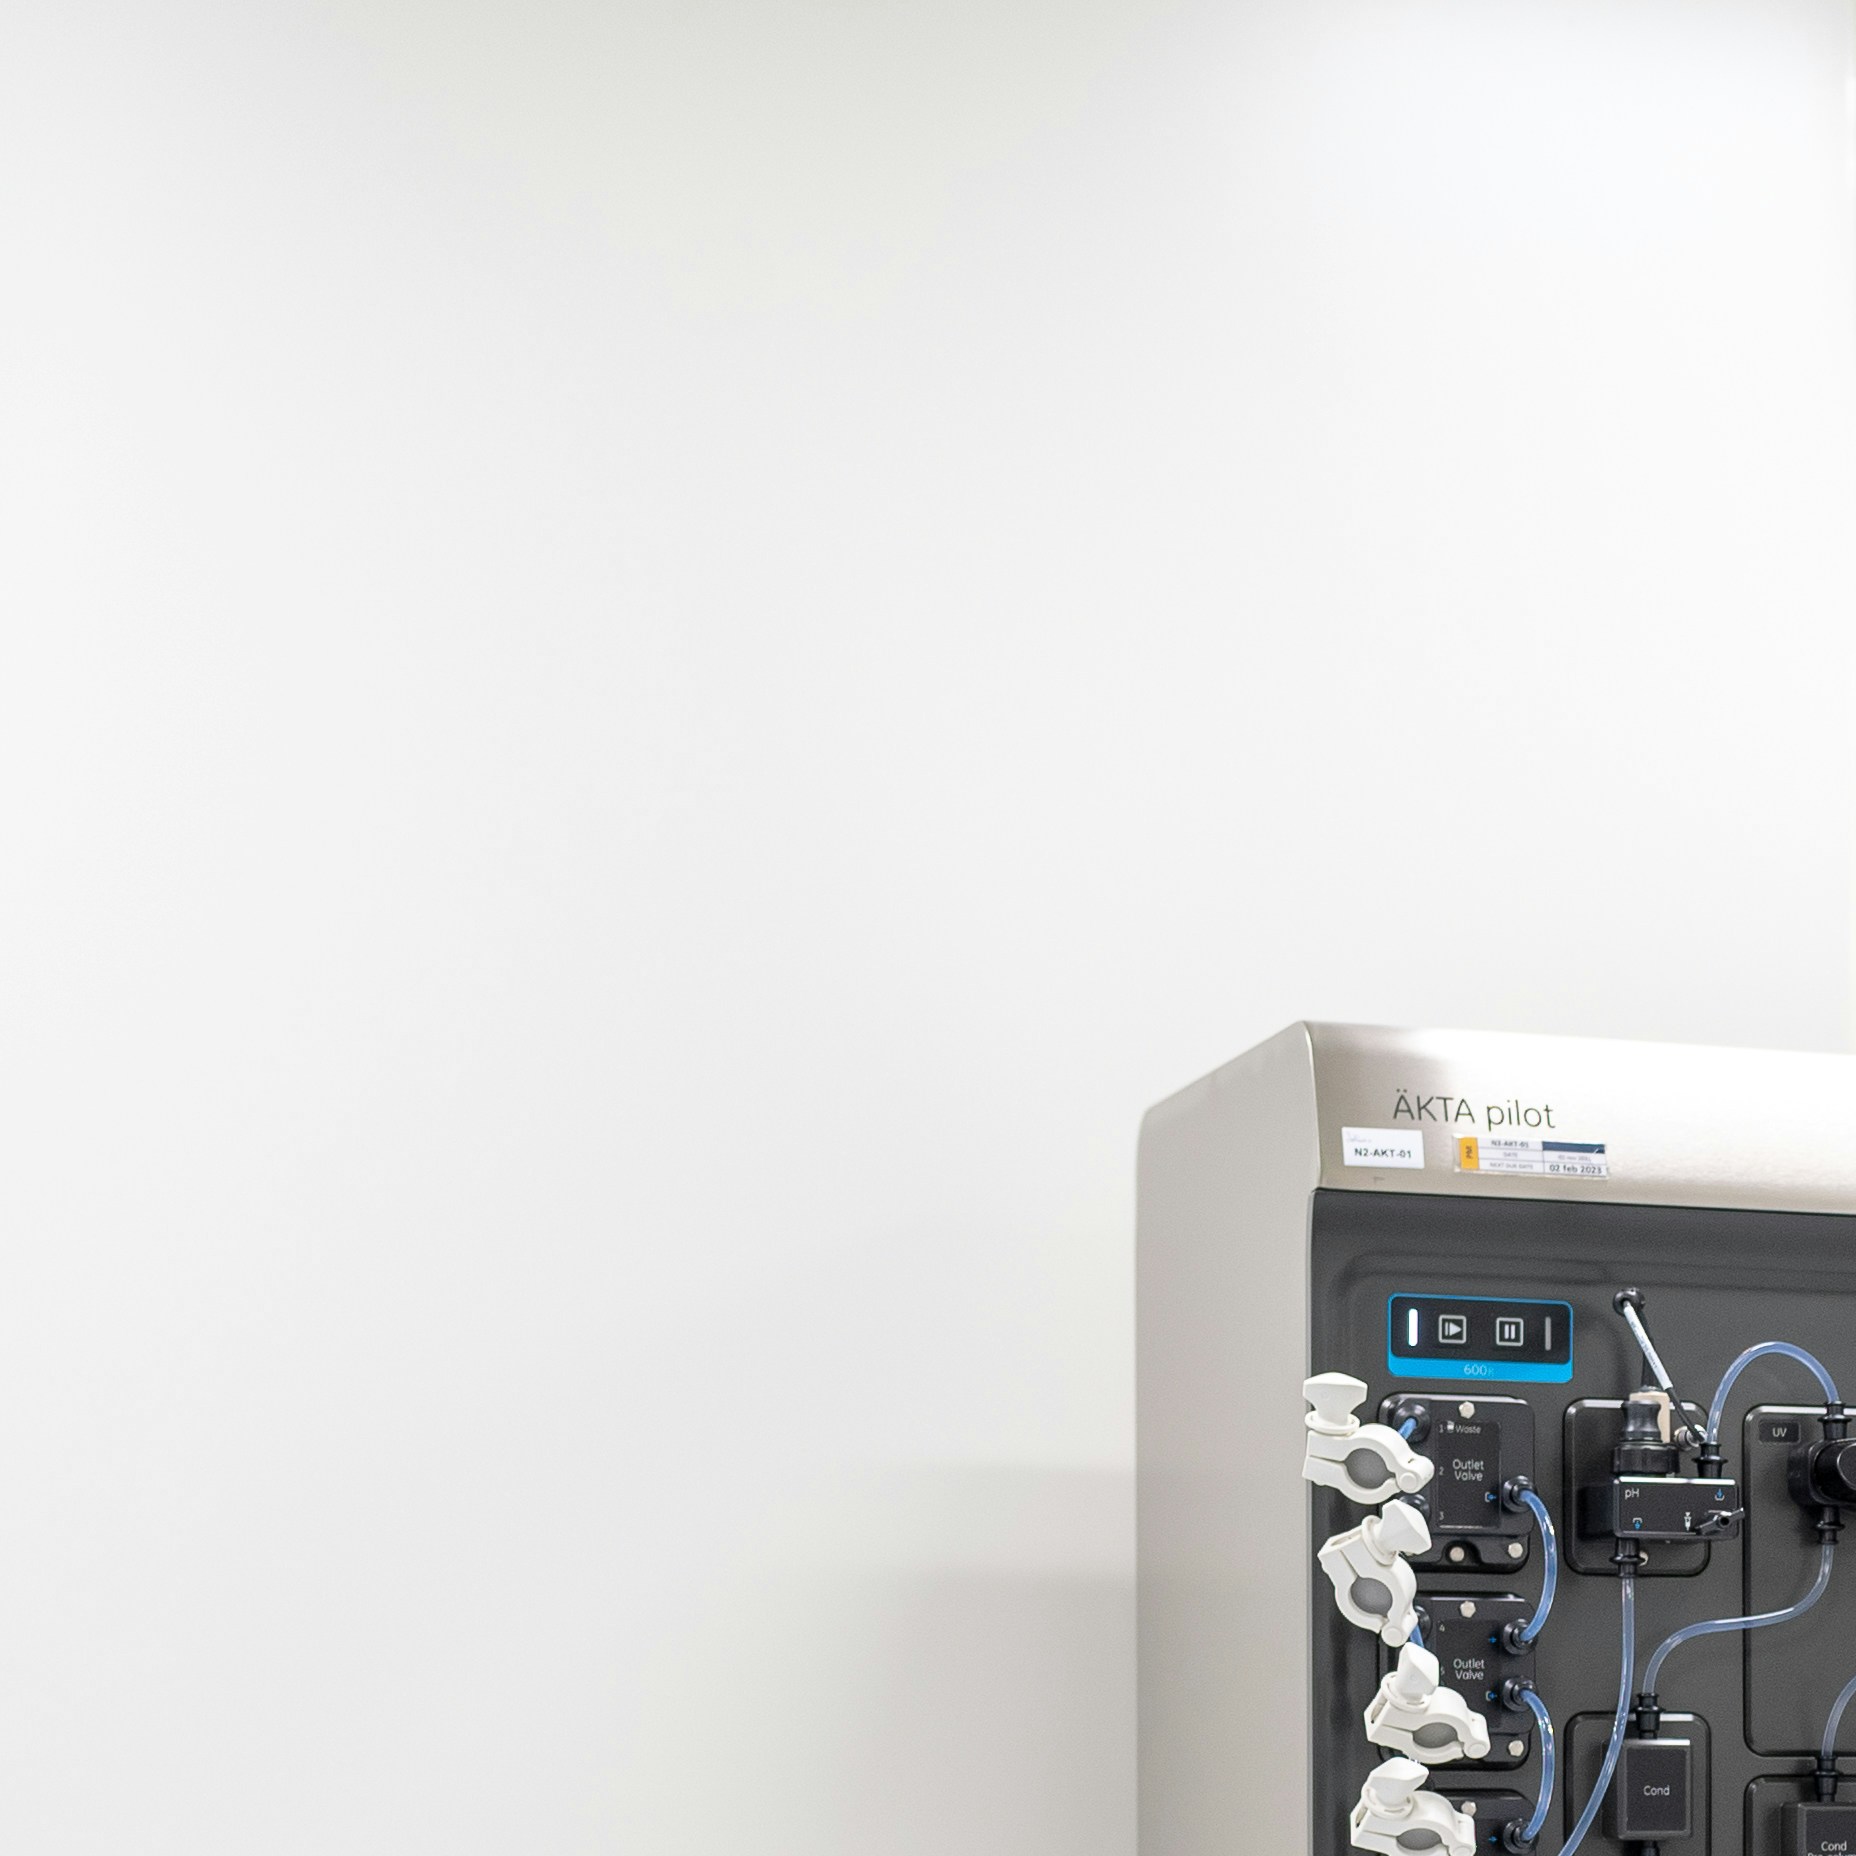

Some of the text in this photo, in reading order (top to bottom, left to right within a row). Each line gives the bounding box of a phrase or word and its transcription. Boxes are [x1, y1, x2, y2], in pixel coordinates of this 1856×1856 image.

[1393, 1088, 1556, 1132] ÄKTA pilot
[1354, 1147, 1412, 1159] N2-AKT-01
[1549, 1164, 1561, 1172] 02
[1563, 1164, 1578, 1173] feb
[1456, 1424, 1482, 1434] Waste
[1772, 1427, 1788, 1438] UV
[1452, 1459, 1484, 1470] Outlet
[1439, 1466, 1445, 1476] 2
[1454, 1470, 1484, 1481] Valve
[1624, 1487, 1640, 1500] pH
[1453, 1658, 1486, 1670] Outlet
[1455, 1669, 1485, 1680] Valve
[1643, 1784, 1670, 1796] Cond
[1820, 1841, 1848, 1852] Cond
